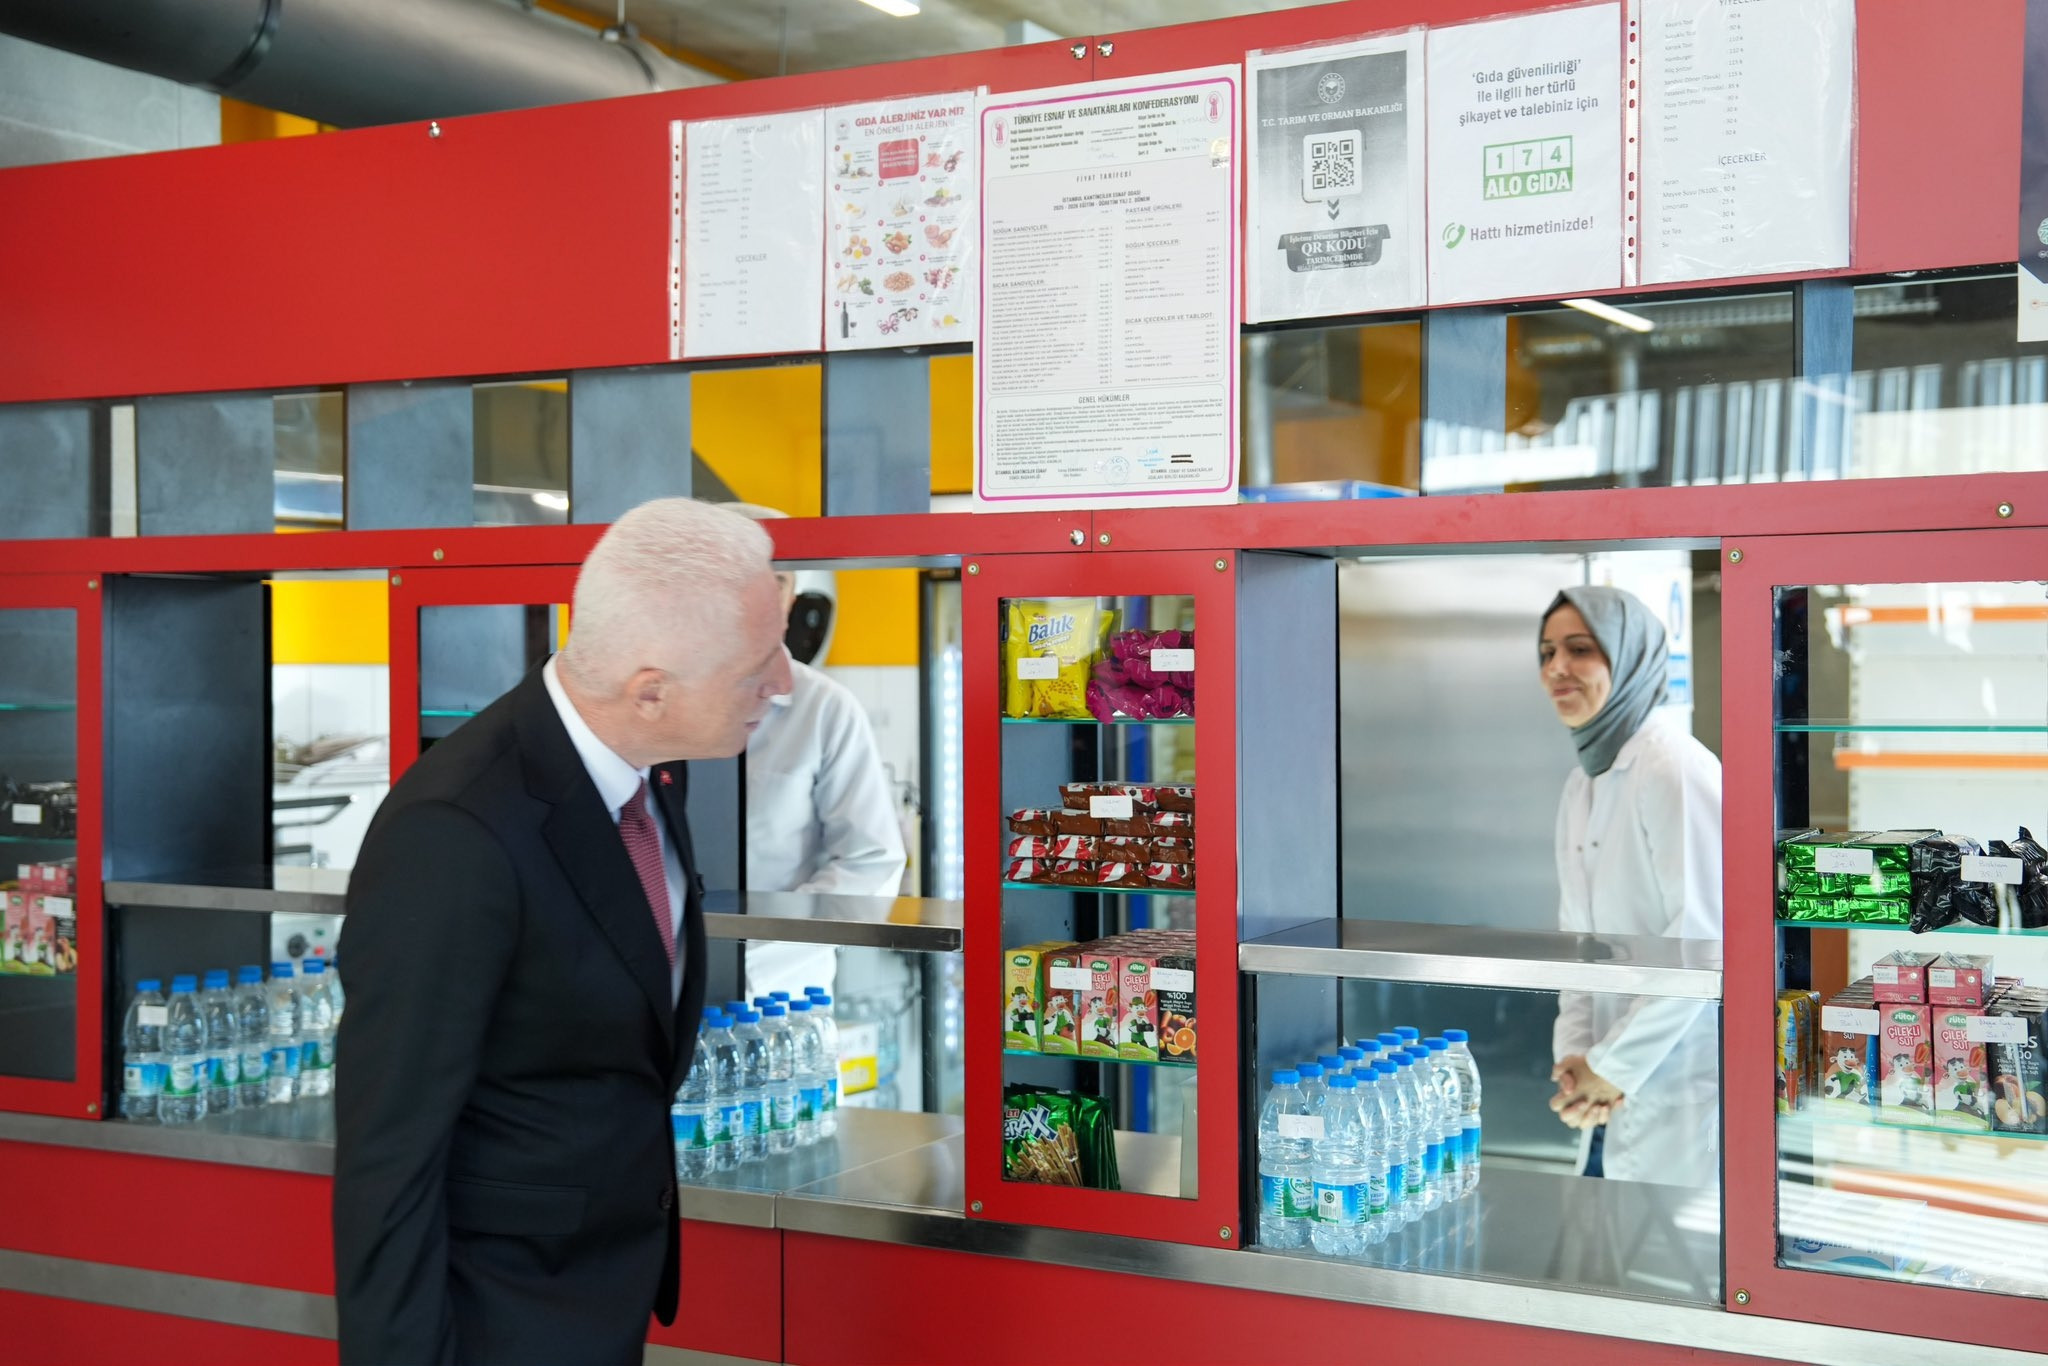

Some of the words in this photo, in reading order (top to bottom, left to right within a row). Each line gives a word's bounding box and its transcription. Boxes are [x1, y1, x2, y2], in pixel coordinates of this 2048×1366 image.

[1477, 91, 1492, 103] ile
[1496, 86, 1522, 103] ilgili
[1525, 85, 1544, 97] her
[1547, 79, 1576, 94] türlü
[855, 117, 877, 127] GIDA
[928, 108, 947, 119] VAR
[1014, 112, 1042, 125] TÜRKİYE
[1044, 110, 1066, 122] ESNAF
[1068, 109, 1077, 119] VE
[1133, 95, 1199, 111] KONFEDERASYONU
[1278, 115, 1306, 126] TARIM
[1308, 113, 1320, 122] VE
[1321, 109, 1354, 121] ORMAN
[1355, 102, 1402, 117] BAKANLIĞI
[1459, 108, 1502, 127] şikayet
[1504, 108, 1517, 119] ve
[1521, 99, 1573, 117] talebiniz
[1577, 96, 1599, 112] için
[864, 128, 875, 137] EN
[1496, 152, 1503, 169] 1
[1522, 149, 1533, 166] 7
[1550, 145, 1562, 163] 4
[1718, 152, 1767, 166] İÇECEKLER
[1485, 175, 1523, 198] ALO
[1526, 170, 1570, 194] GIDA
[1470, 227, 1501, 241] Hattı
[1505, 216, 1594, 238] hizmetinizde!
[1301, 241, 1323, 256] QR
[1326, 237, 1367, 253] KODU
[1078, 395, 1097, 404] GENEL
[1028, 615, 1074, 644] Balık
[1166, 992, 1187, 1000] %100
[1948, 1015, 1967, 1024] süta
[1888, 1026, 1920, 1039] ÇİLEKLİ
[1942, 1029, 1967, 1042] ÇİLEK
